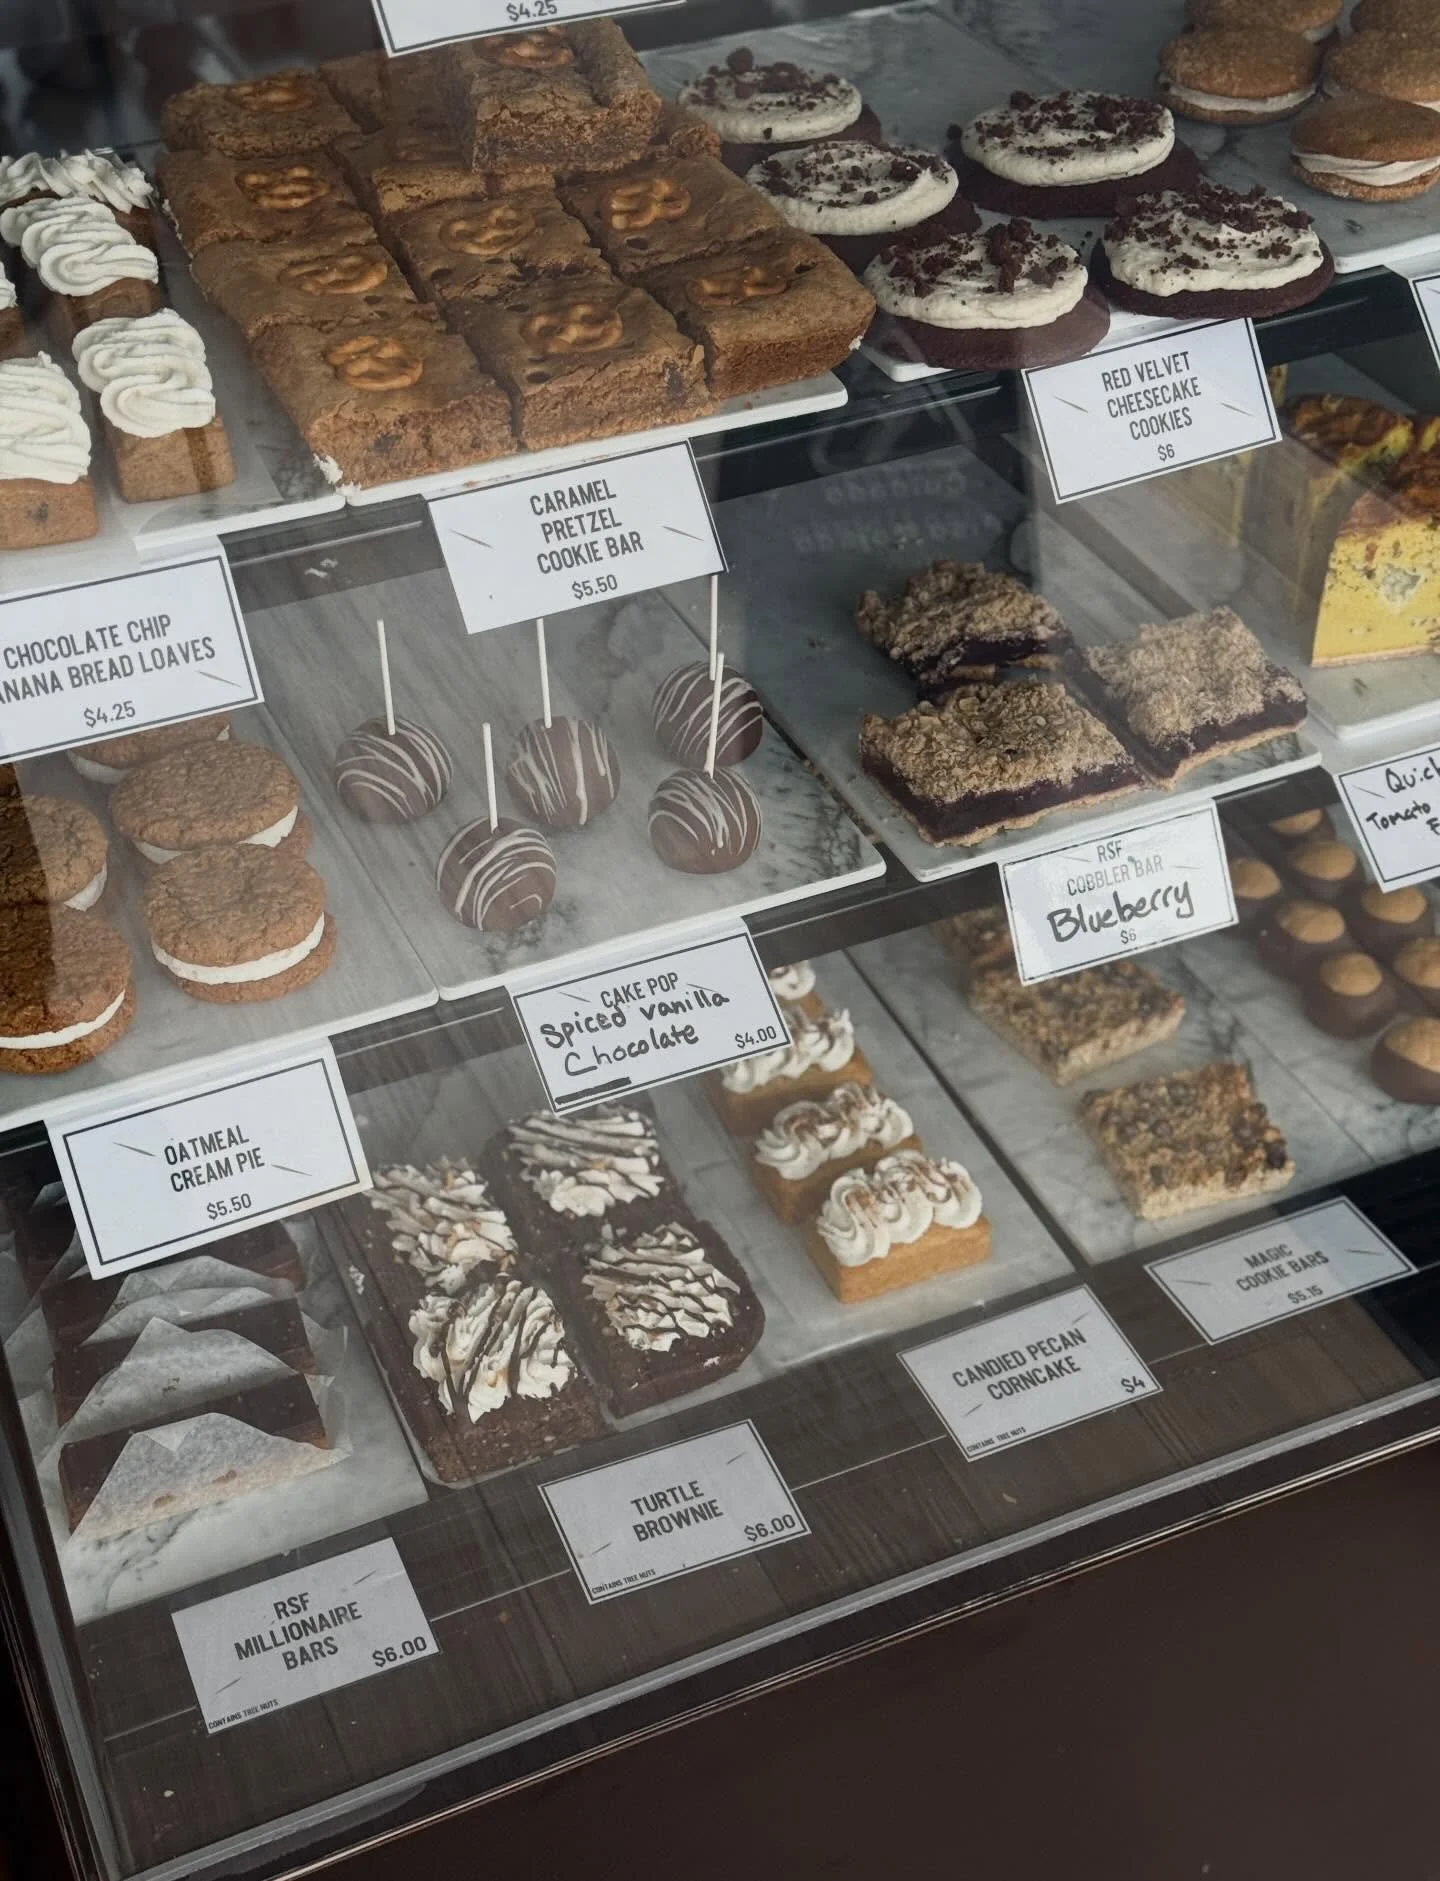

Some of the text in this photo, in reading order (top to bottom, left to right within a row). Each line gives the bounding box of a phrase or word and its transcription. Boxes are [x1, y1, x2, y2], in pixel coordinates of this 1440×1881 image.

[506, 0, 558, 22] $4.25
[1101, 351, 1190, 392] RED VELVET
[1107, 376, 1202, 418] CHEESECAKE
[1129, 406, 1193, 440] COOKIES
[1157, 443, 1175, 463] $6
[529, 479, 617, 516] CARAMEL
[541, 507, 622, 543] PRETZEL
[536, 530, 645, 574] COOKIE BAR
[571, 574, 618, 600] $5.50
[3, 614, 172, 670] CHOCOLATE CHIP
[67, 654, 135, 689] BREAD
[138, 636, 216, 673] LOAVES
[83, 700, 137, 728] $4.25
[1096, 839, 1123, 863] RSF
[1067, 853, 1165, 897] COBBLER BAR
[1046, 880, 1195, 943] Blueberry
[600, 971, 679, 1008] CAKE POP
[540, 1005, 627, 1049] Spiced
[734, 1025, 778, 1050] $4.00
[564, 1023, 700, 1077] Chocolate
[164, 1124, 250, 1165] OATMEAL
[170, 1147, 265, 1193] CREAM PIE
[206, 1193, 252, 1220] $5.50
[1236, 1250, 1330, 1292] COOKIE BARS
[1243, 1243, 1294, 1269] MAGIC
[952, 1327, 1087, 1388] CANDIED PECAN
[986, 1355, 1081, 1401] CORNCAKE
[1120, 1375, 1146, 1394] $4
[630, 1480, 705, 1516] TURTLE
[632, 1498, 724, 1543] BROWNIE
[744, 1514, 796, 1542] $6.00
[273, 1592, 309, 1620] RSF
[233, 1601, 363, 1661] MILLIONAIRE
[281, 1635, 338, 1671] BARS
[371, 1635, 428, 1668] $6.00
[208, 1699, 279, 1730] CONTAINS TREE NUTS
